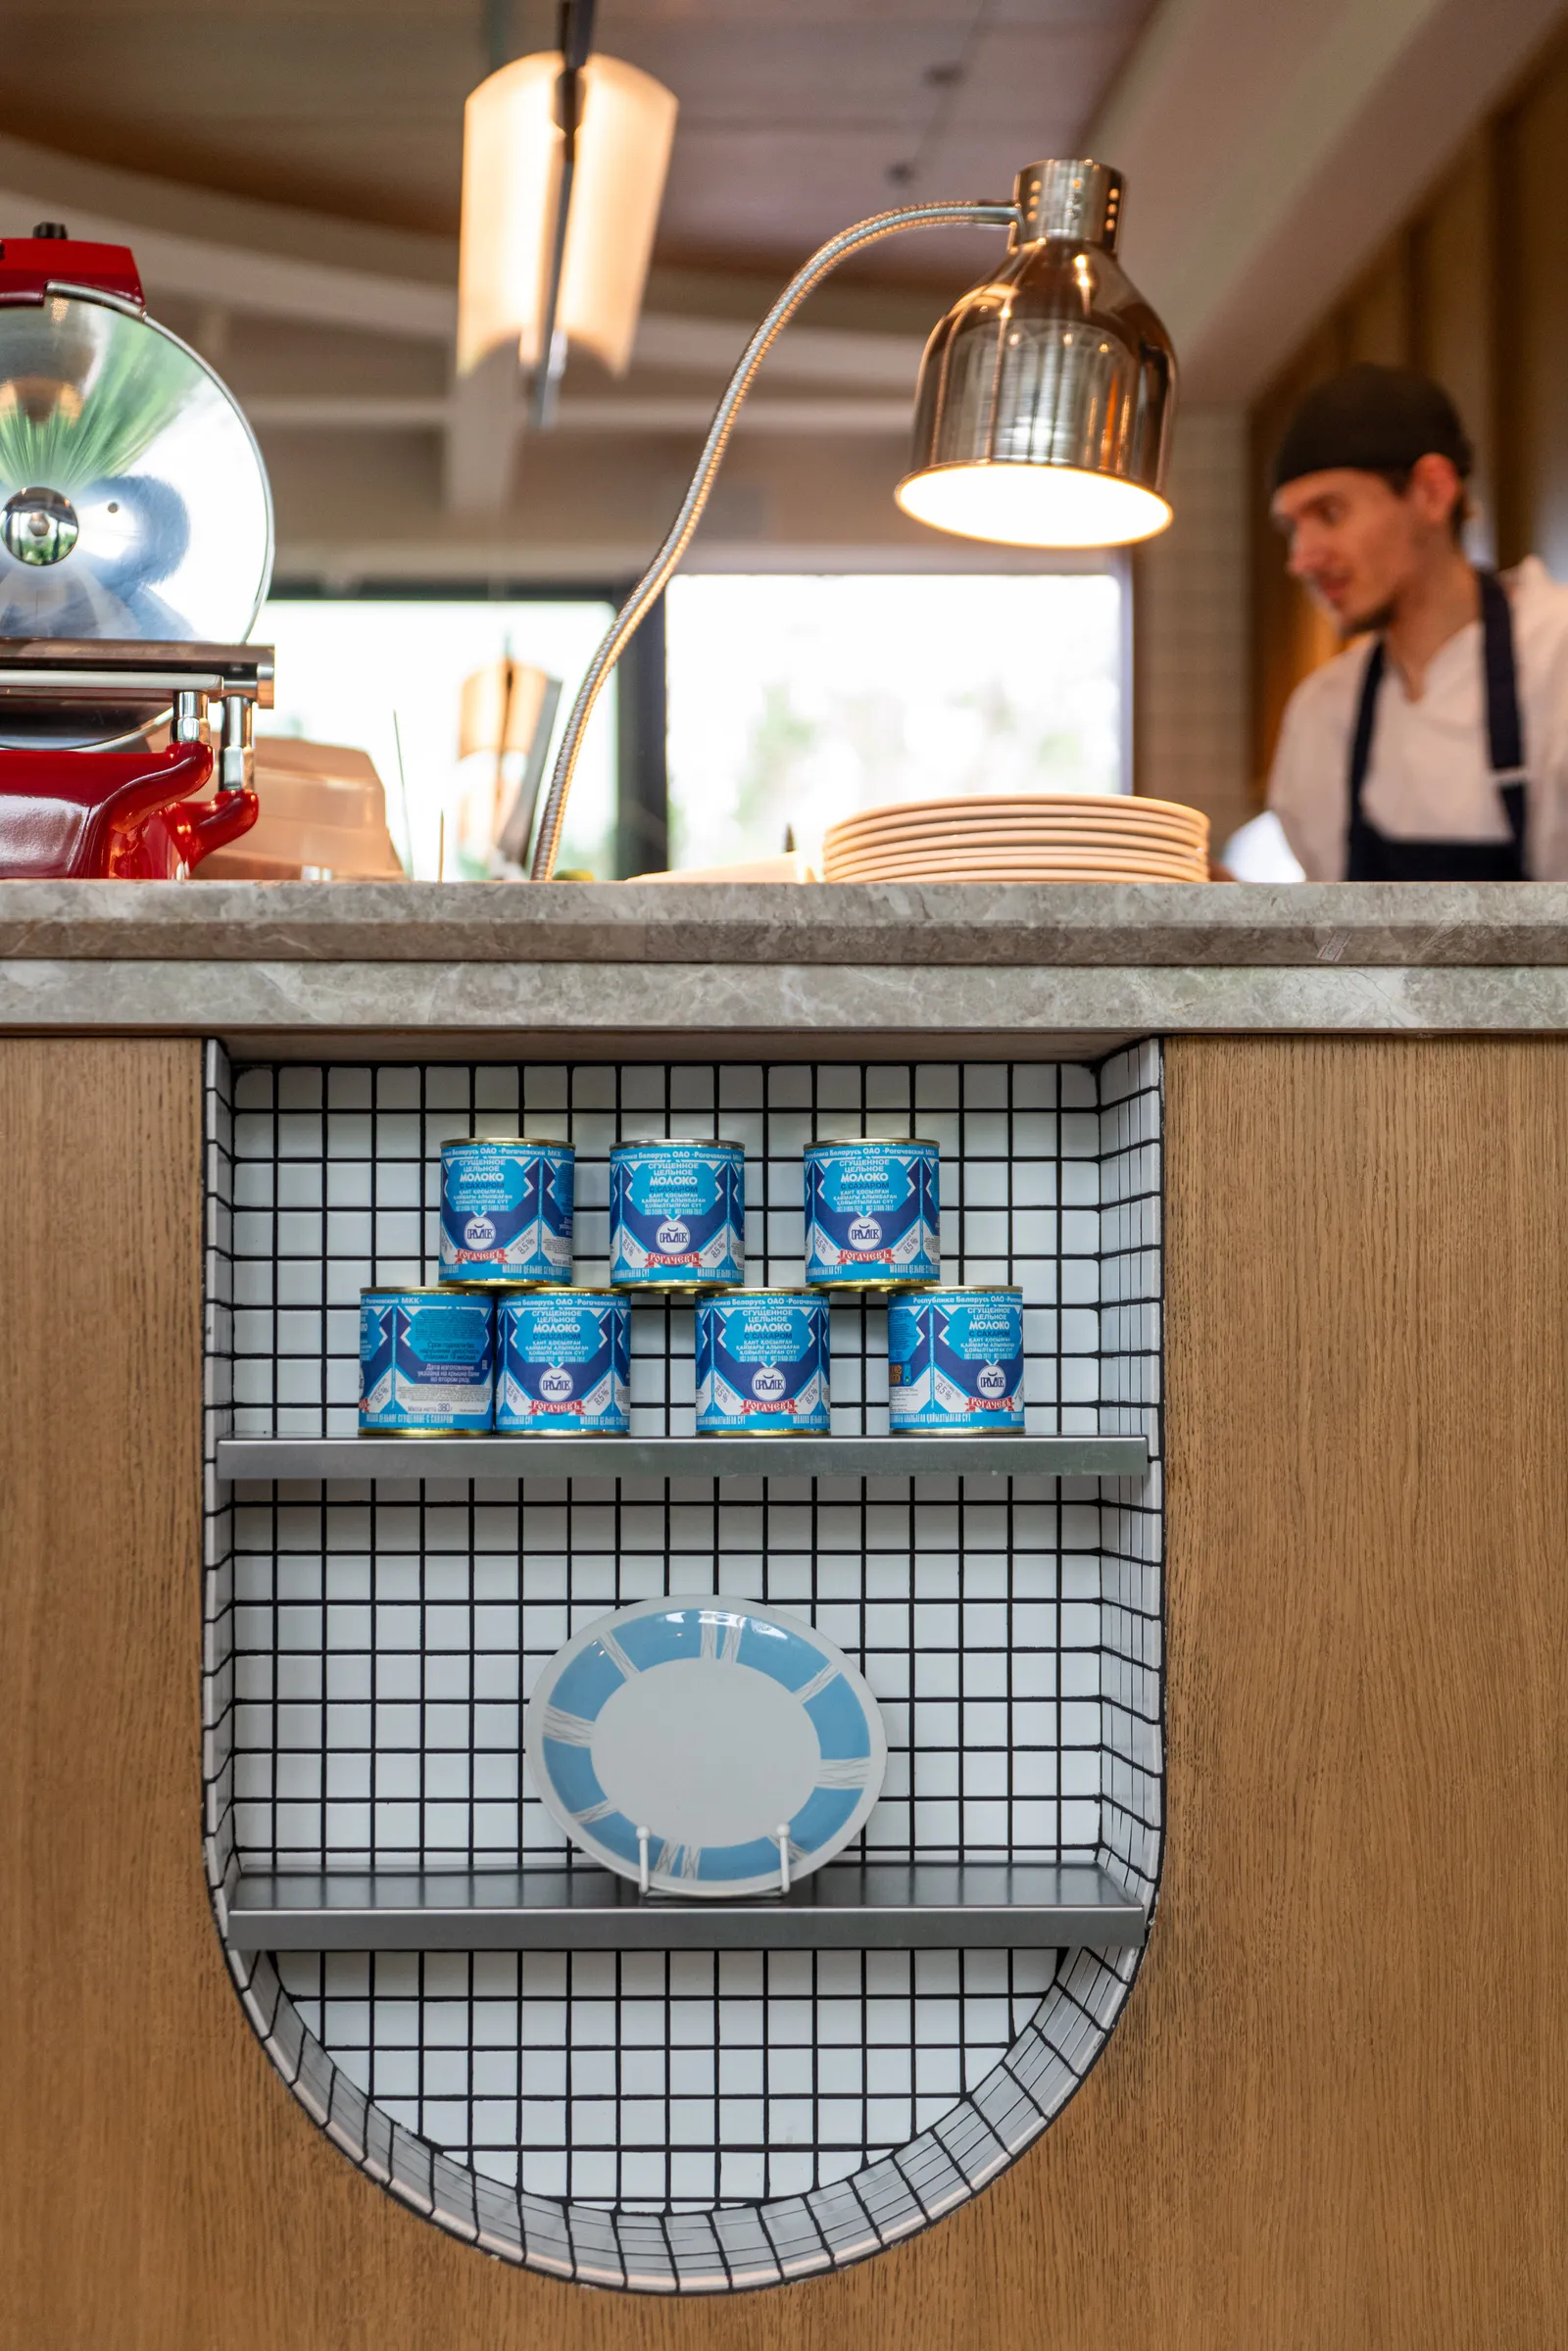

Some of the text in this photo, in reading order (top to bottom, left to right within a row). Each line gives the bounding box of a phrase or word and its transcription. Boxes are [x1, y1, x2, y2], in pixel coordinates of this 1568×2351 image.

[913, 1297, 954, 1305] Республика
[533, 1324, 580, 1333] МОЛОКО
[437, 1403, 451, 1412] 380
